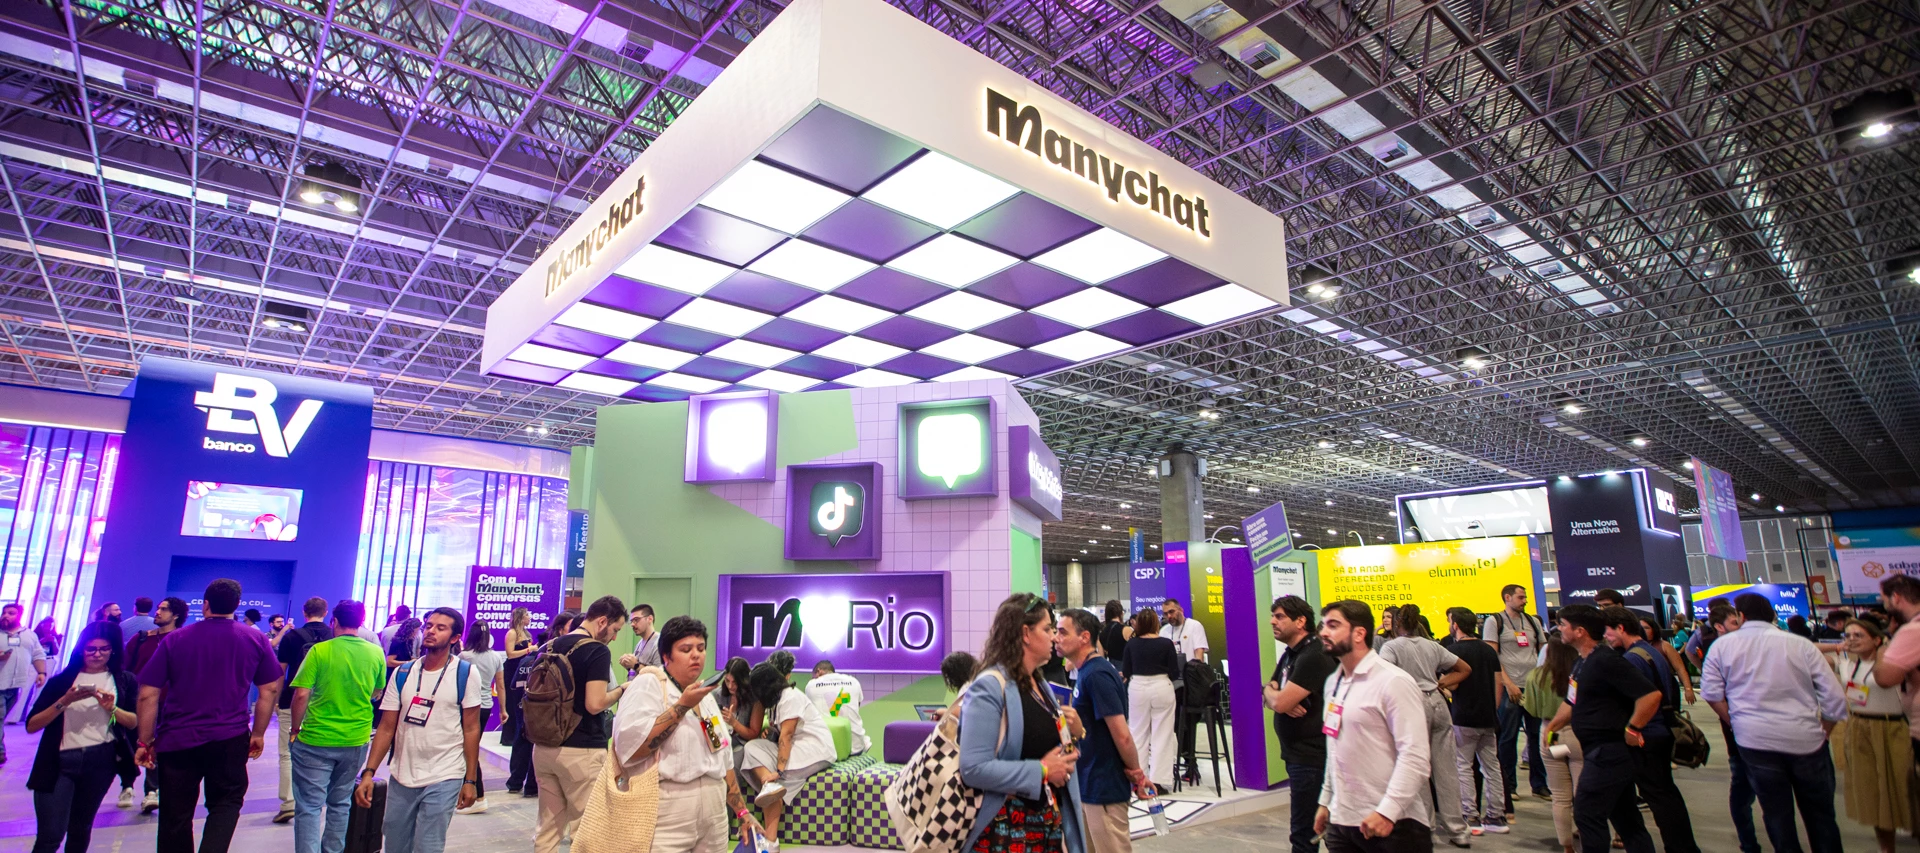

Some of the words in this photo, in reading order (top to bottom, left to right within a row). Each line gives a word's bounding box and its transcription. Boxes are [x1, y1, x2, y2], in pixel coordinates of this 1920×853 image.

[986, 86, 1210, 238] Manychat
[545, 174, 645, 298] Manychat
[203, 437, 256, 453] banco
[1570, 521, 1592, 529] Uma
[1593, 519, 1618, 527] Nova
[578, 513, 589, 552] Meetup
[1570, 526, 1620, 536] Alternativa
[576, 558, 585, 568] 3
[1272, 565, 1298, 575] Manychat
[1333, 565, 1345, 574] HÁ
[1360, 565, 1385, 573] ANOS
[1428, 564, 1477, 578] elumini
[1587, 567, 1616, 576] OKX
[478, 573, 506, 584] Com
[507, 576, 517, 584] a
[1333, 574, 1396, 583] OFERECENDO
[477, 583, 545, 595] Manychat,
[476, 594, 541, 602] conversas
[1399, 593, 1413, 601] DO
[476, 601, 512, 611] viram
[847, 596, 934, 651] Rio
